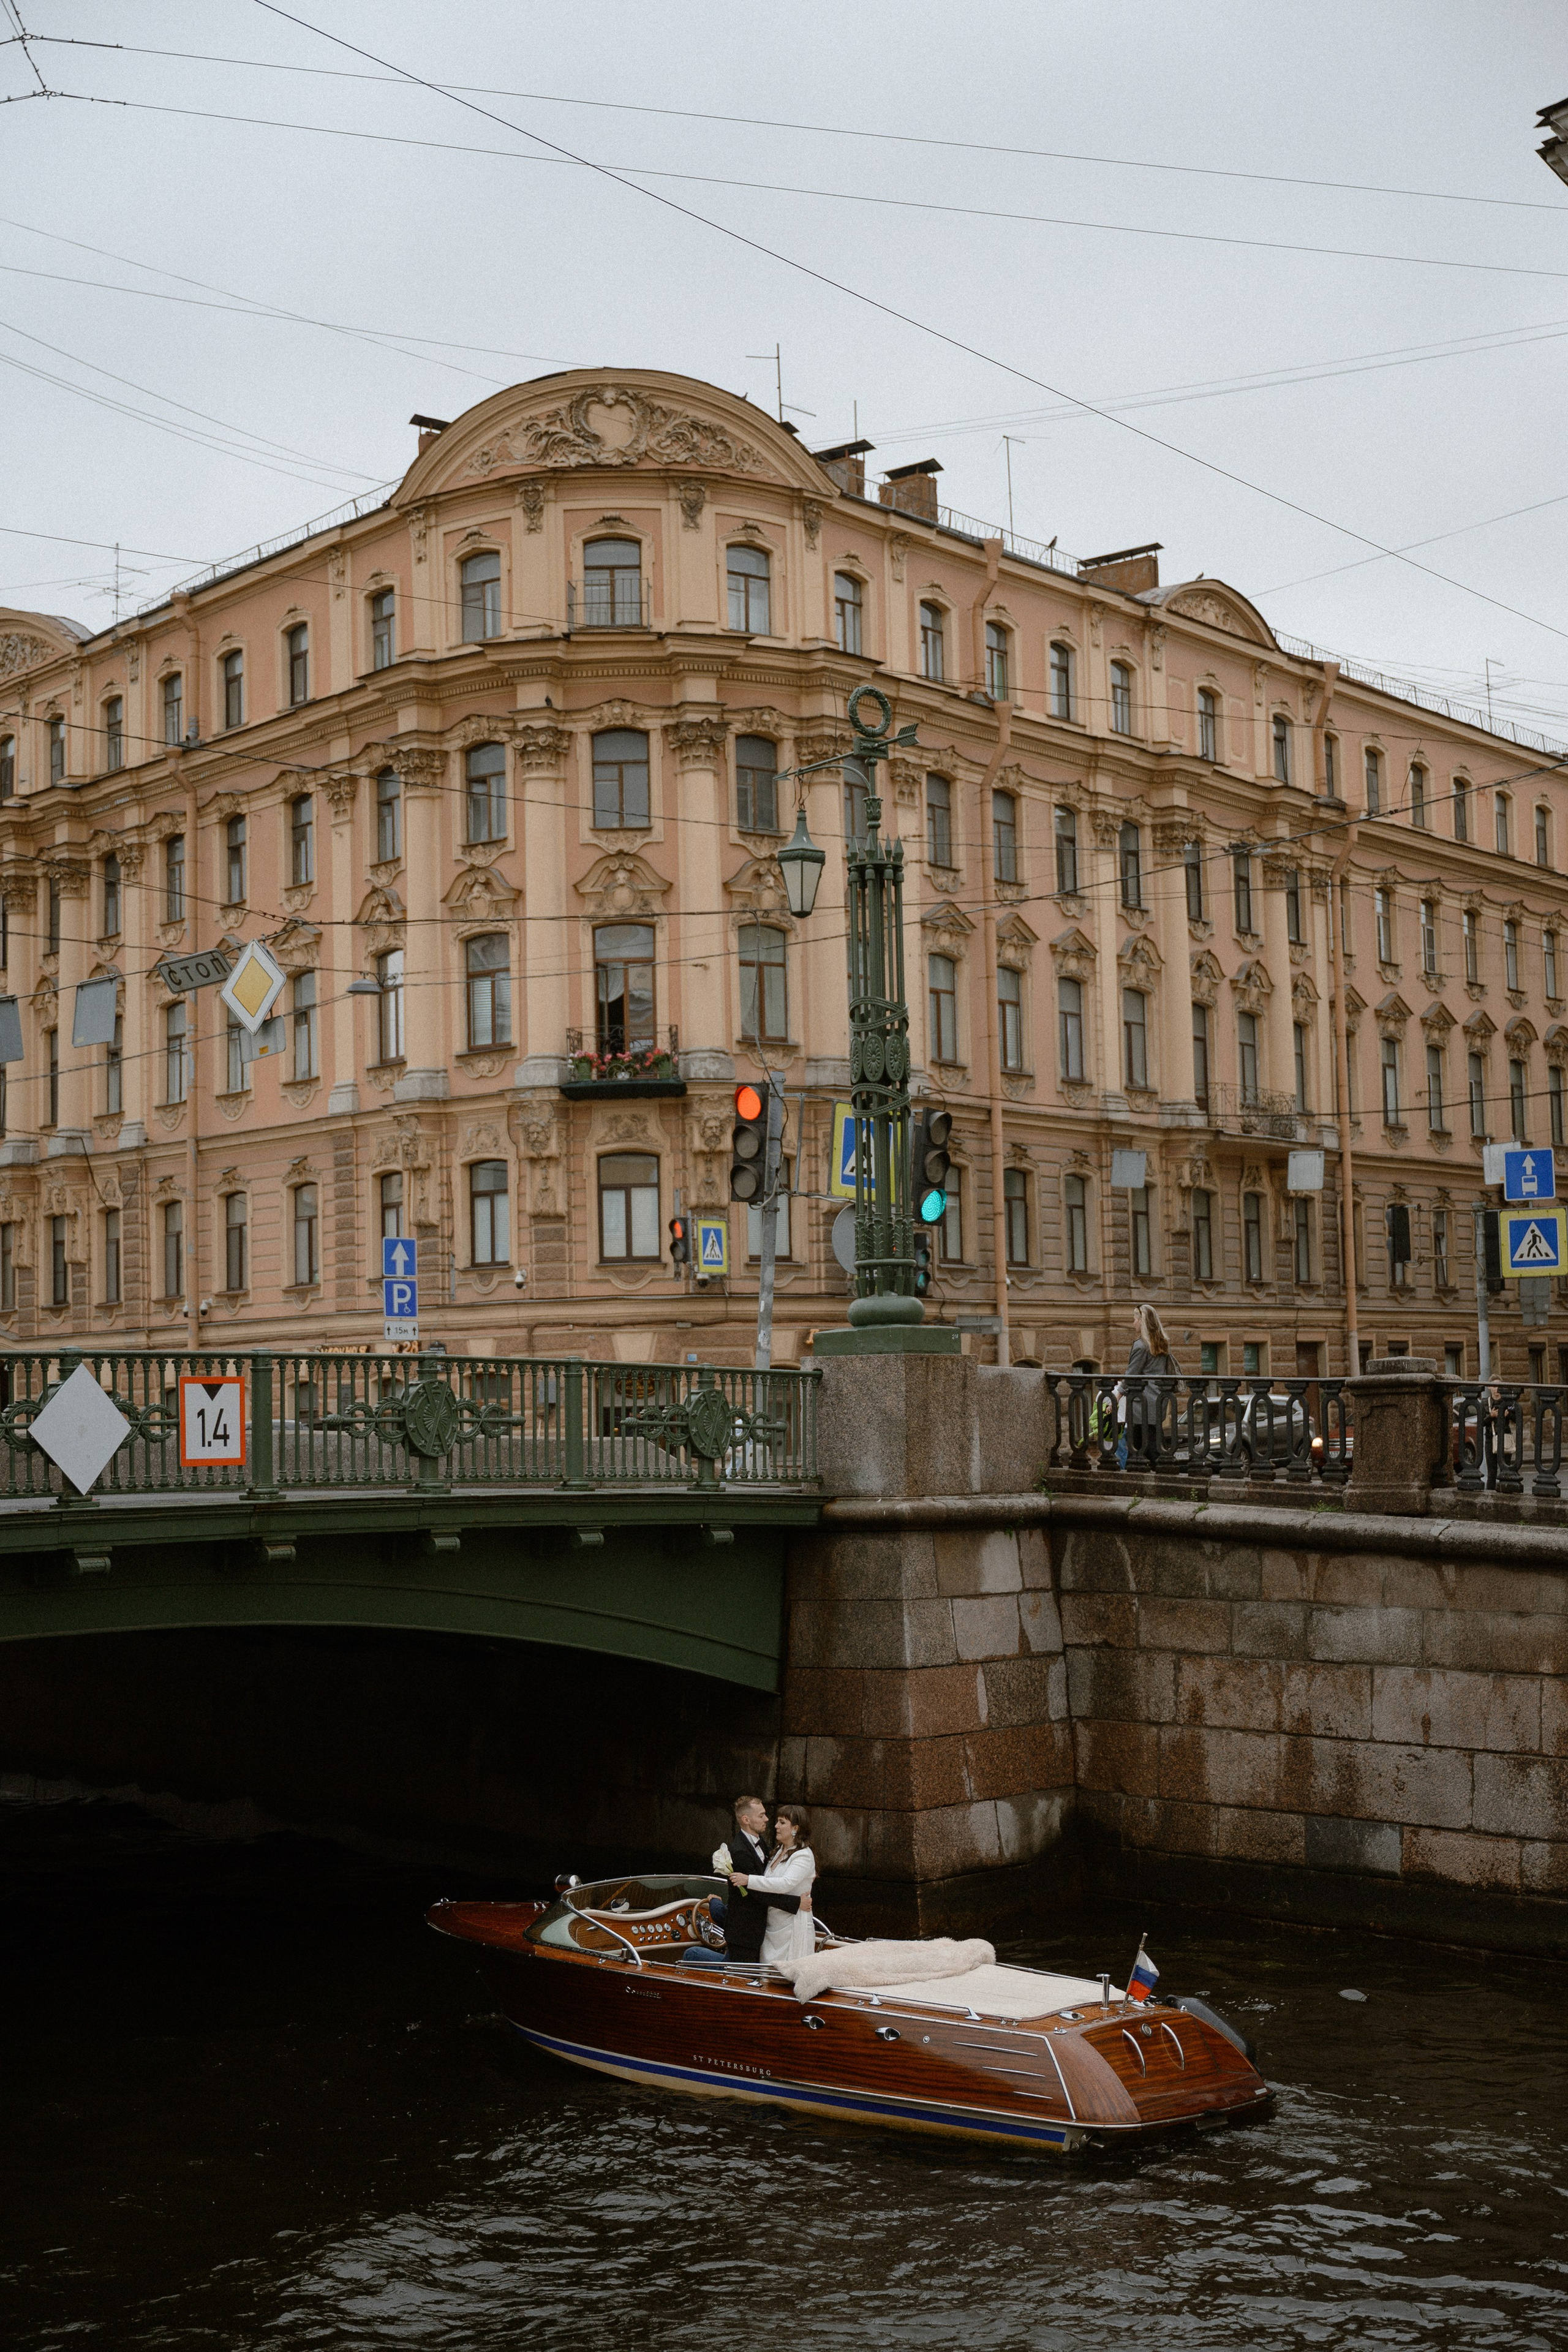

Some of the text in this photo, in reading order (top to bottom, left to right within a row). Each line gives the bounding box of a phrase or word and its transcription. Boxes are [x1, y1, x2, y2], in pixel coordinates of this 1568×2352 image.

[168, 957, 227, 986] СТОП
[393, 1283, 412, 1314] P
[197, 1408, 230, 1447] 1.4
[707, 2057, 771, 2076] PETERSBURG
